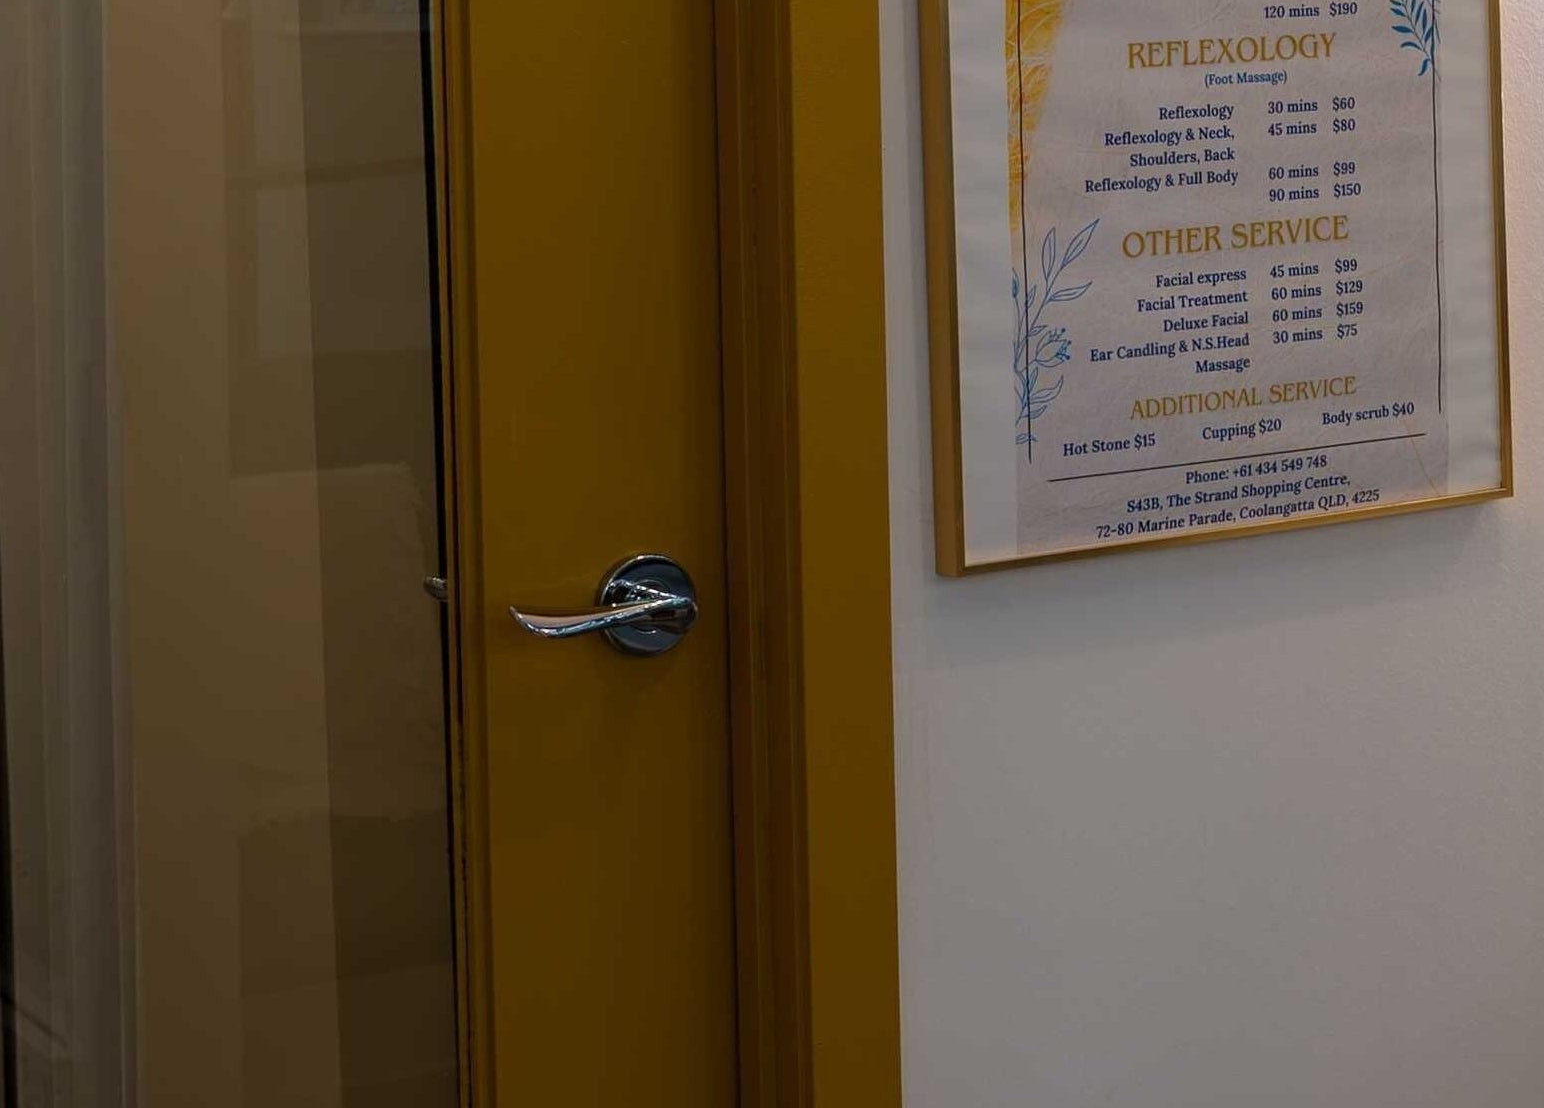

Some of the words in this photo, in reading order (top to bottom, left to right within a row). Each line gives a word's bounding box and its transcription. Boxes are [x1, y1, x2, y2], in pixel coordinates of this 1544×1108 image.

[1264, 6, 1285, 19] 120
[1289, 5, 1319, 17] mins
[1329, 2, 1358, 16] $190
[1128, 32, 1336, 69] REFLEXOLOGY
[1205, 72, 1233, 88] (Foot
[1237, 70, 1287, 84] Massage)
[1159, 105, 1234, 121] Reflexology
[1268, 101, 1283, 114] 30
[1287, 99, 1318, 112] mins
[1333, 96, 1355, 111] $60
[1105, 131, 1182, 147] Reflexology
[1186, 128, 1195, 140] &
[1199, 126, 1235, 140] Neck,
[1268, 123, 1282, 136] 45
[1286, 122, 1317, 135] mins
[1333, 118, 1356, 133] $80
[1130, 152, 1200, 167] Shoulders,
[1204, 148, 1235, 162] Back
[1085, 177, 1161, 193] Reflexology
[1165, 174, 1174, 187] &
[1178, 170, 1202, 185] Full
[1207, 169, 1238, 186] Body
[1269, 167, 1284, 180] 60
[1288, 166, 1319, 178] mins
[1333, 161, 1355, 176] $99
[1269, 189, 1285, 202] 90
[1288, 187, 1319, 201] mins
[1334, 182, 1361, 198] $150
[1122, 225, 1222, 259] OTHER
[1231, 215, 1349, 248] SERVICE
[1156, 273, 1193, 288] Facial
[1197, 270, 1246, 287] express
[1270, 265, 1285, 278] 45
[1289, 263, 1319, 276] mins
[1335, 259, 1358, 274] $99
[1137, 298, 1175, 312] Facial
[1178, 292, 1248, 309] Treatment
[1271, 287, 1287, 300] 60
[1291, 285, 1321, 298] mins
[1336, 280, 1363, 296] $129
[1164, 317, 1208, 332] Deluxe
[1212, 312, 1249, 327] Facial
[1272, 309, 1288, 322] 60
[1292, 307, 1322, 320] mins
[1336, 302, 1364, 317] $159
[1091, 349, 1112, 362] Ear
[1117, 342, 1176, 360] Candling
[1179, 340, 1189, 352] &
[1273, 331, 1288, 344] 30
[1292, 329, 1323, 342] mins
[1337, 324, 1358, 339] $75
[1195, 358, 1250, 374] Massage
[1130, 387, 1262, 420] ADDITIONAL
[1270, 376, 1356, 404] SERVICE
[1063, 443, 1088, 457] Hot
[1092, 438, 1130, 453] Stone
[1134, 433, 1156, 450] $15
[1202, 422, 1255, 441] Cupping
[1259, 418, 1282, 435] $20
[1323, 411, 1352, 427] Body
[1355, 405, 1389, 421] scrub
[1392, 402, 1415, 418] $40
[1186, 469, 1230, 484] Phone:
[1232, 464, 1253, 478] +61
[1255, 460, 1278, 475] 434
[1281, 458, 1303, 472] 549
[1306, 455, 1327, 469] 748
[1127, 496, 1164, 513] S43B,
[1166, 493, 1191, 508] The
[1195, 487, 1238, 504] Strand
[1241, 480, 1302, 501] Shopping
[1304, 473, 1350, 490] Centre,
[1096, 522, 1134, 539] 72-80
[1138, 517, 1185, 533] Marine
[1189, 509, 1236, 527] Parade,
[1239, 499, 1314, 520] Coolangatta
[1318, 496, 1349, 512] QLD,
[1352, 490, 1380, 504] 4225
